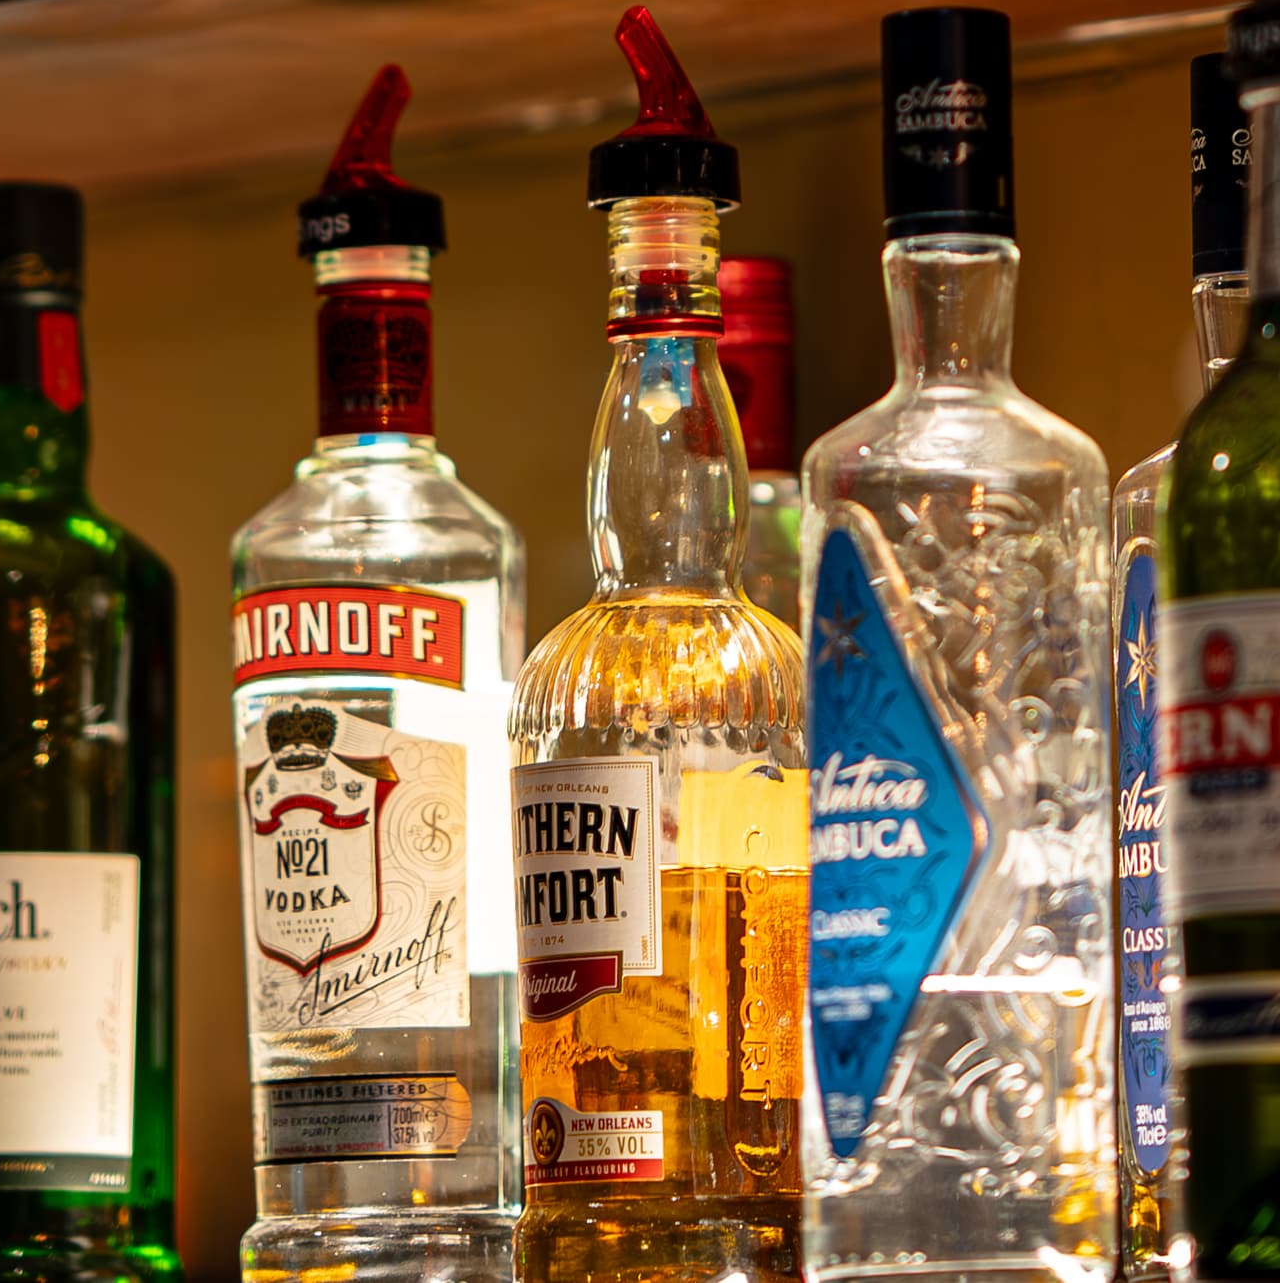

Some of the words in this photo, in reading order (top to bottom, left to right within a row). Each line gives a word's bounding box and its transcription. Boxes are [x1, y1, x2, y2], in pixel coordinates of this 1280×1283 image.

[896, 111, 988, 134] SAMBUCA
[556, 783, 609, 794] ORLEANS
[281, 827, 320, 837] RECIPE
[265, 884, 351, 913] VODKA
[289, 896, 460, 1026] Smirnoff
[299, 1086, 343, 1099] TIMES
[353, 1083, 428, 1097] FILTERED
[291, 1114, 383, 1128] EXTRAORDINARY
[571, 1118, 595, 1131] NEW
[598, 1117, 653, 1130] ORLEANS
[302, 1127, 340, 1138] PURITY
[578, 1137, 611, 1156] 35%
[617, 1136, 654, 1155] VOL.
[574, 1162, 636, 1175] FLAVOURING
